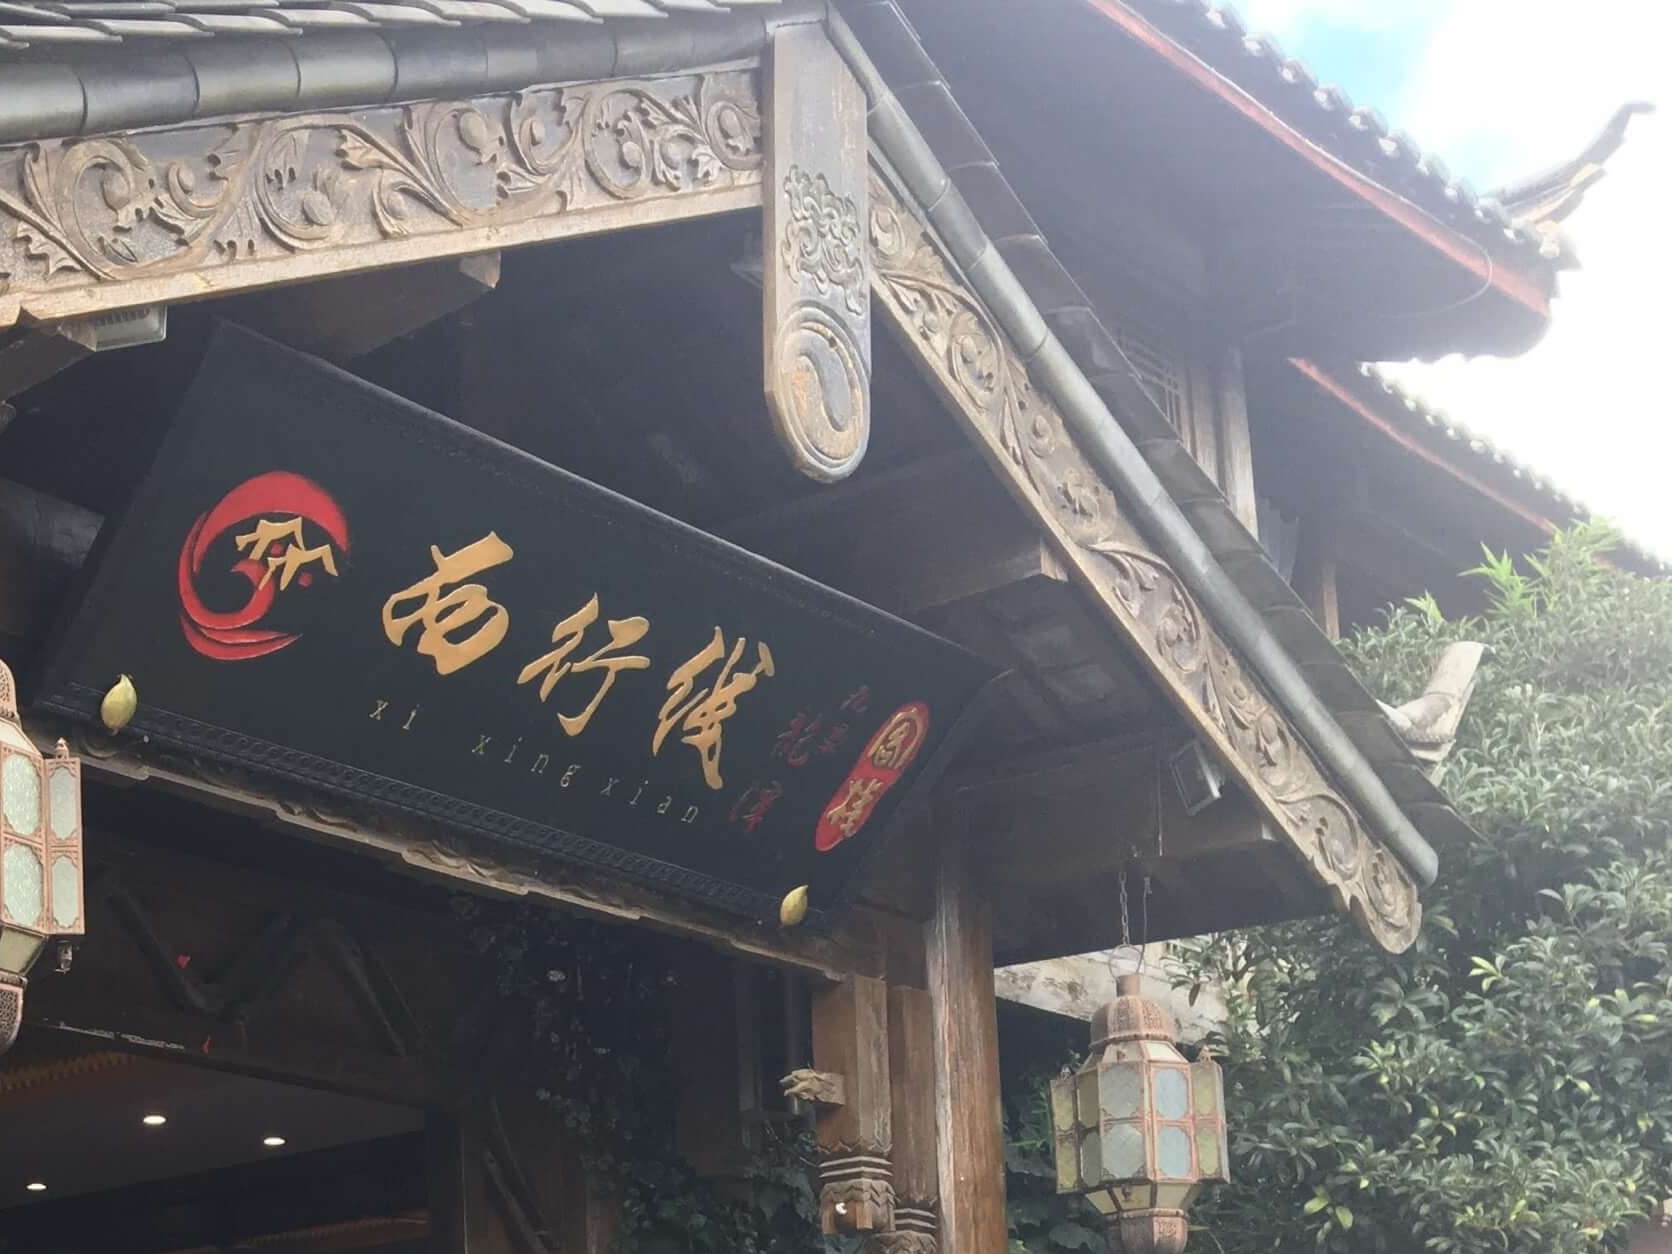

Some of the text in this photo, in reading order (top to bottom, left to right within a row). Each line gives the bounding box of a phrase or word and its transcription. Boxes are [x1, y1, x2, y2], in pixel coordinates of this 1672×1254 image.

[368, 698, 700, 825] xi xing xian
